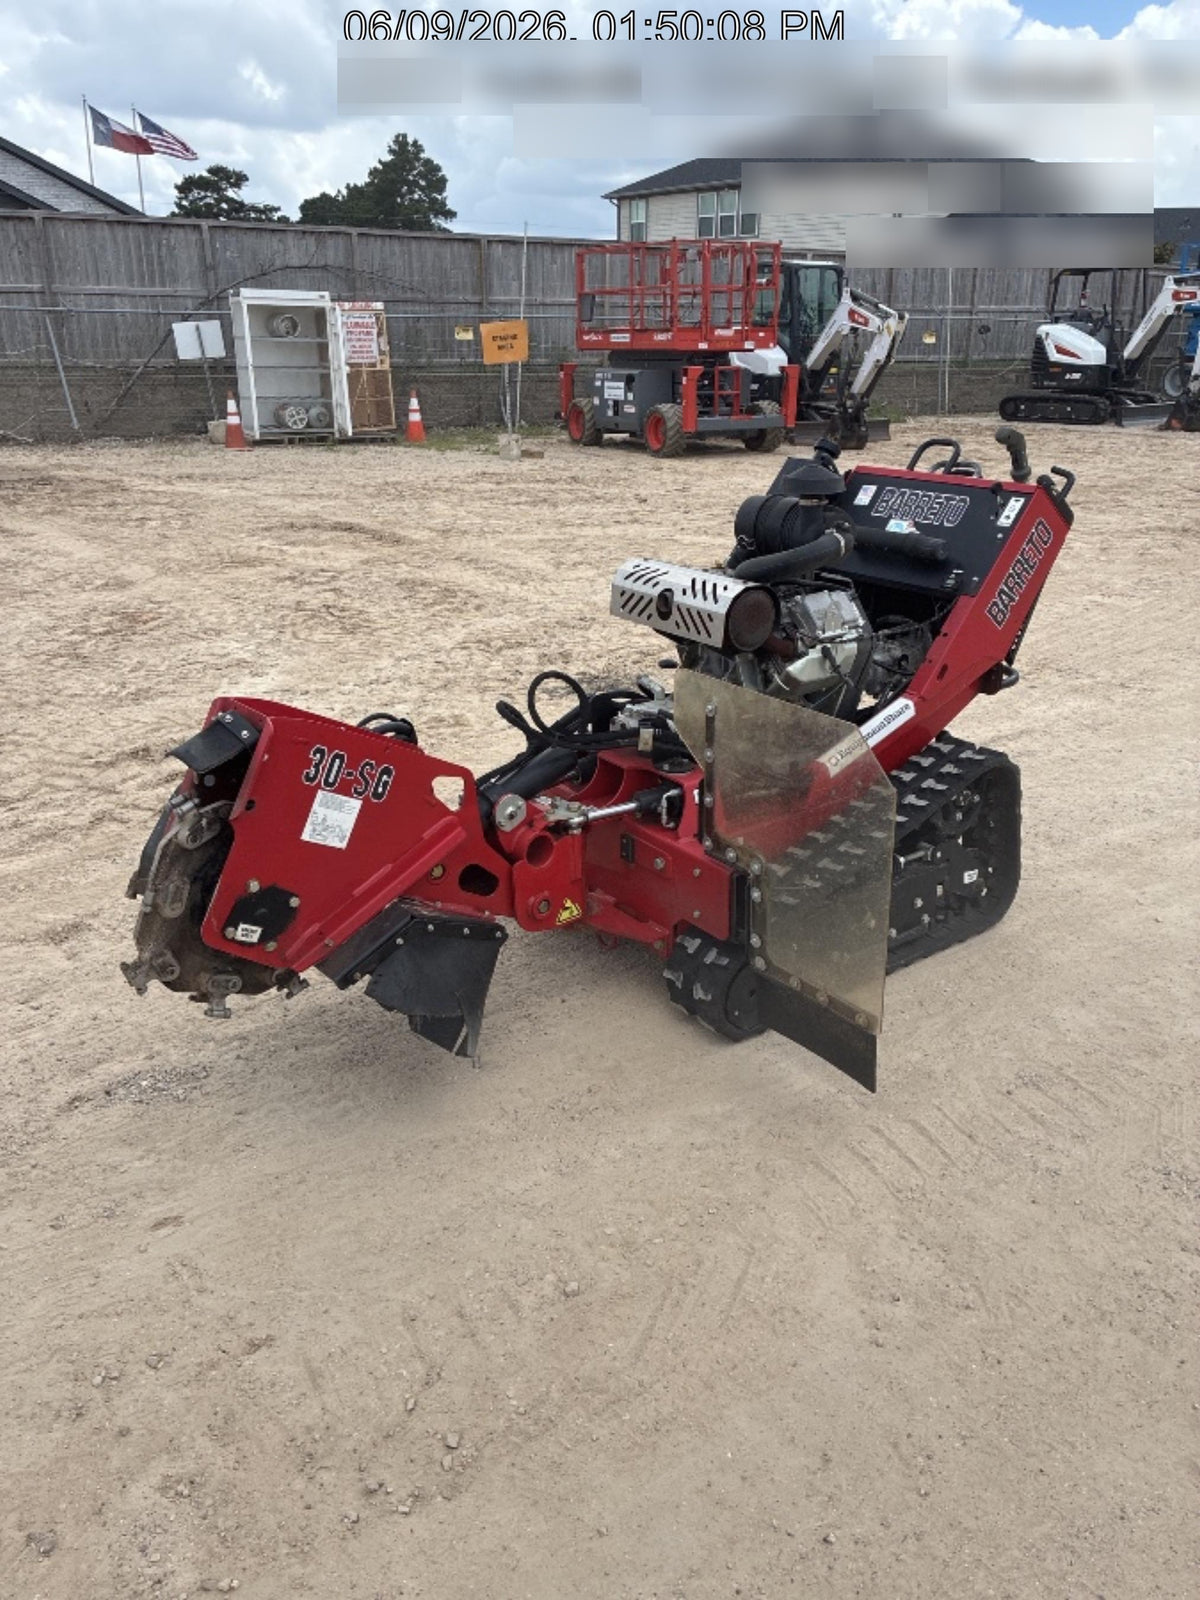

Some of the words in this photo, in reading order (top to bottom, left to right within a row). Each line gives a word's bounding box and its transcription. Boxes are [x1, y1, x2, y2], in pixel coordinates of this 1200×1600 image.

[871, 486, 970, 527] BARRETO
[984, 516, 1054, 630] BARRETO
[302, 744, 395, 802] 30-SG
